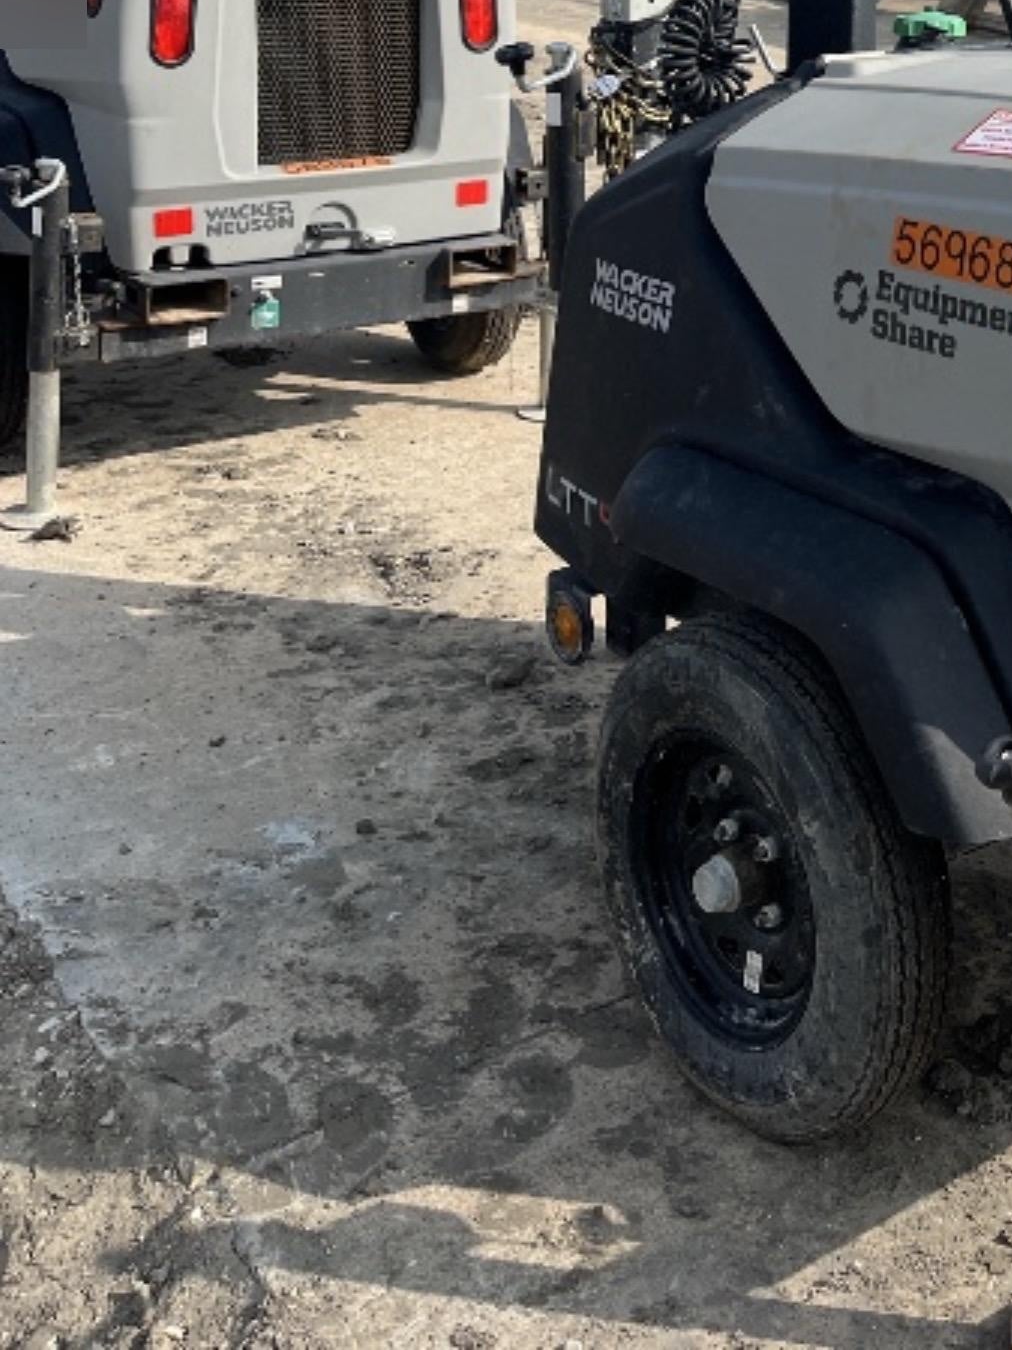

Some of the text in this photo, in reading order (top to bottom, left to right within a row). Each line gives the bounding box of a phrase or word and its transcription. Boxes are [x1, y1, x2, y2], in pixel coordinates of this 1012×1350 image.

[205, 200, 294, 222] WACKER
[206, 215, 295, 238] NEUSON
[595, 257, 677, 308] WACKER
[589, 282, 673, 334] NEUSON
[870, 308, 957, 358] Share
